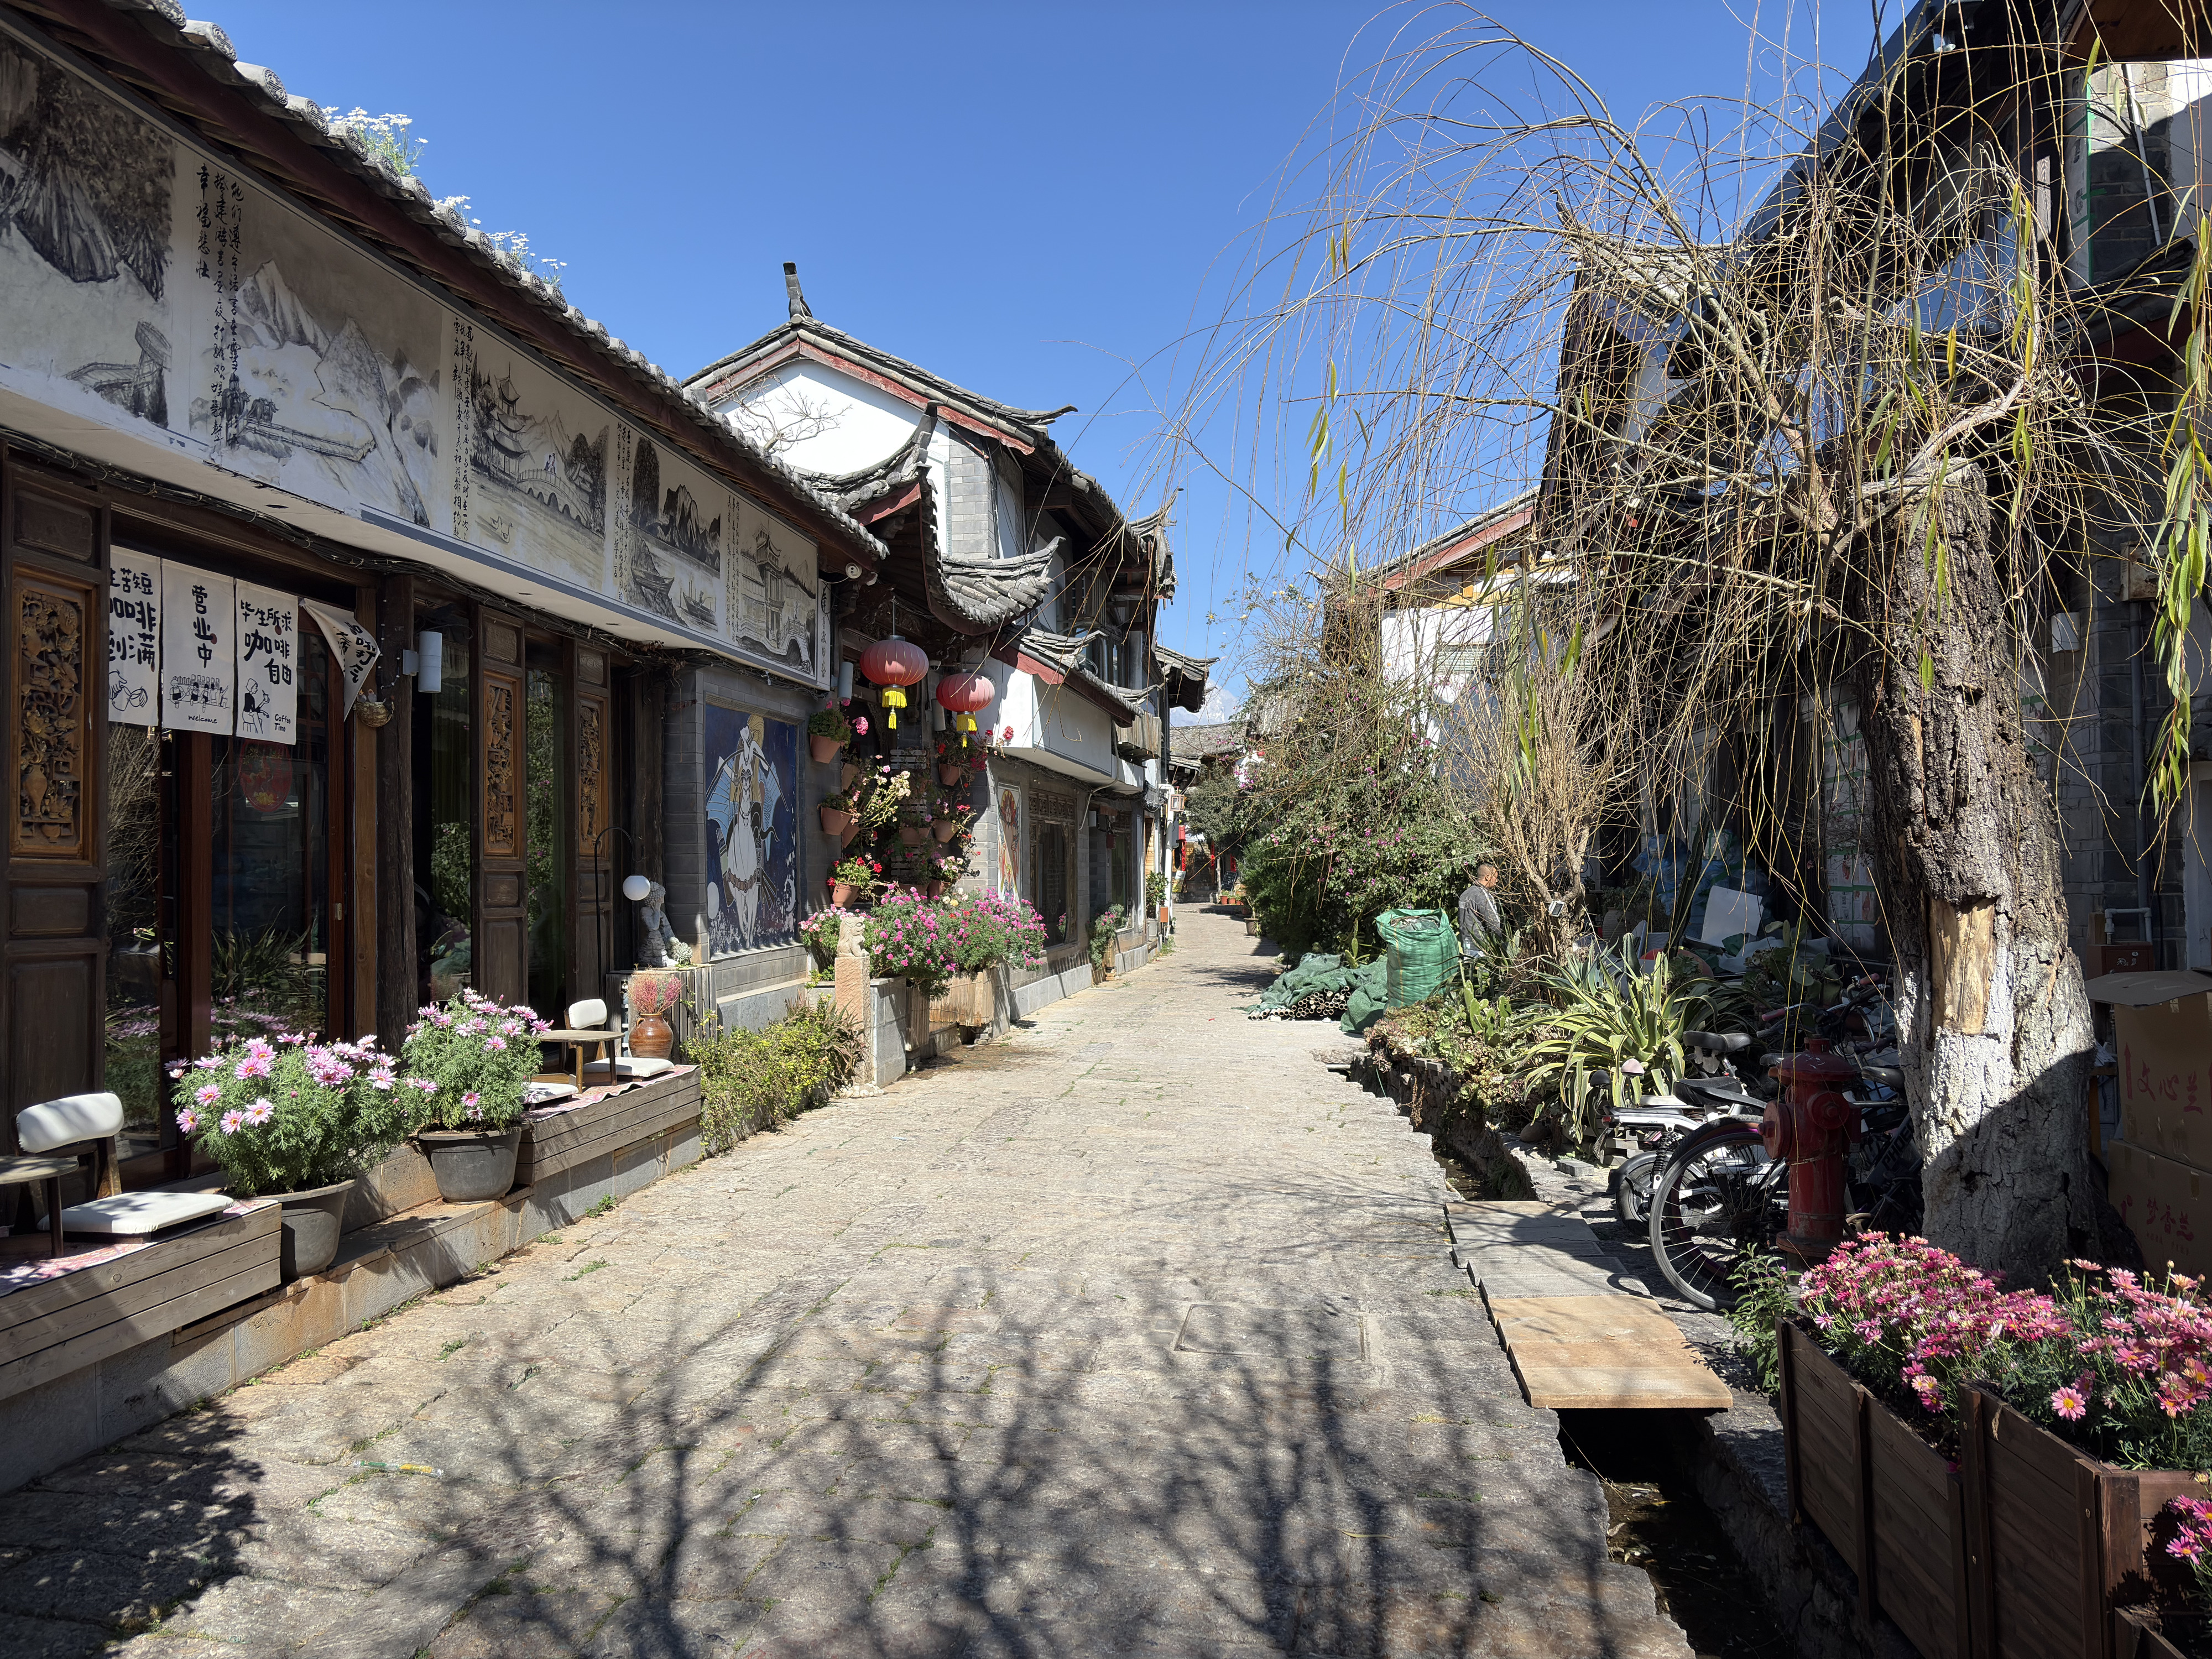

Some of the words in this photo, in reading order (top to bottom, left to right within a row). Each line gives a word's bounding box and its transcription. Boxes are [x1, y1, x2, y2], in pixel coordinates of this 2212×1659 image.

[192, 585, 214, 669] 营业中
[241, 599, 293, 632] 毕生所求
[244, 629, 290, 661] 咖啡
[264, 658, 291, 685] 自由
[274, 713, 291, 724] Coffee
[274, 723, 286, 732] Time
